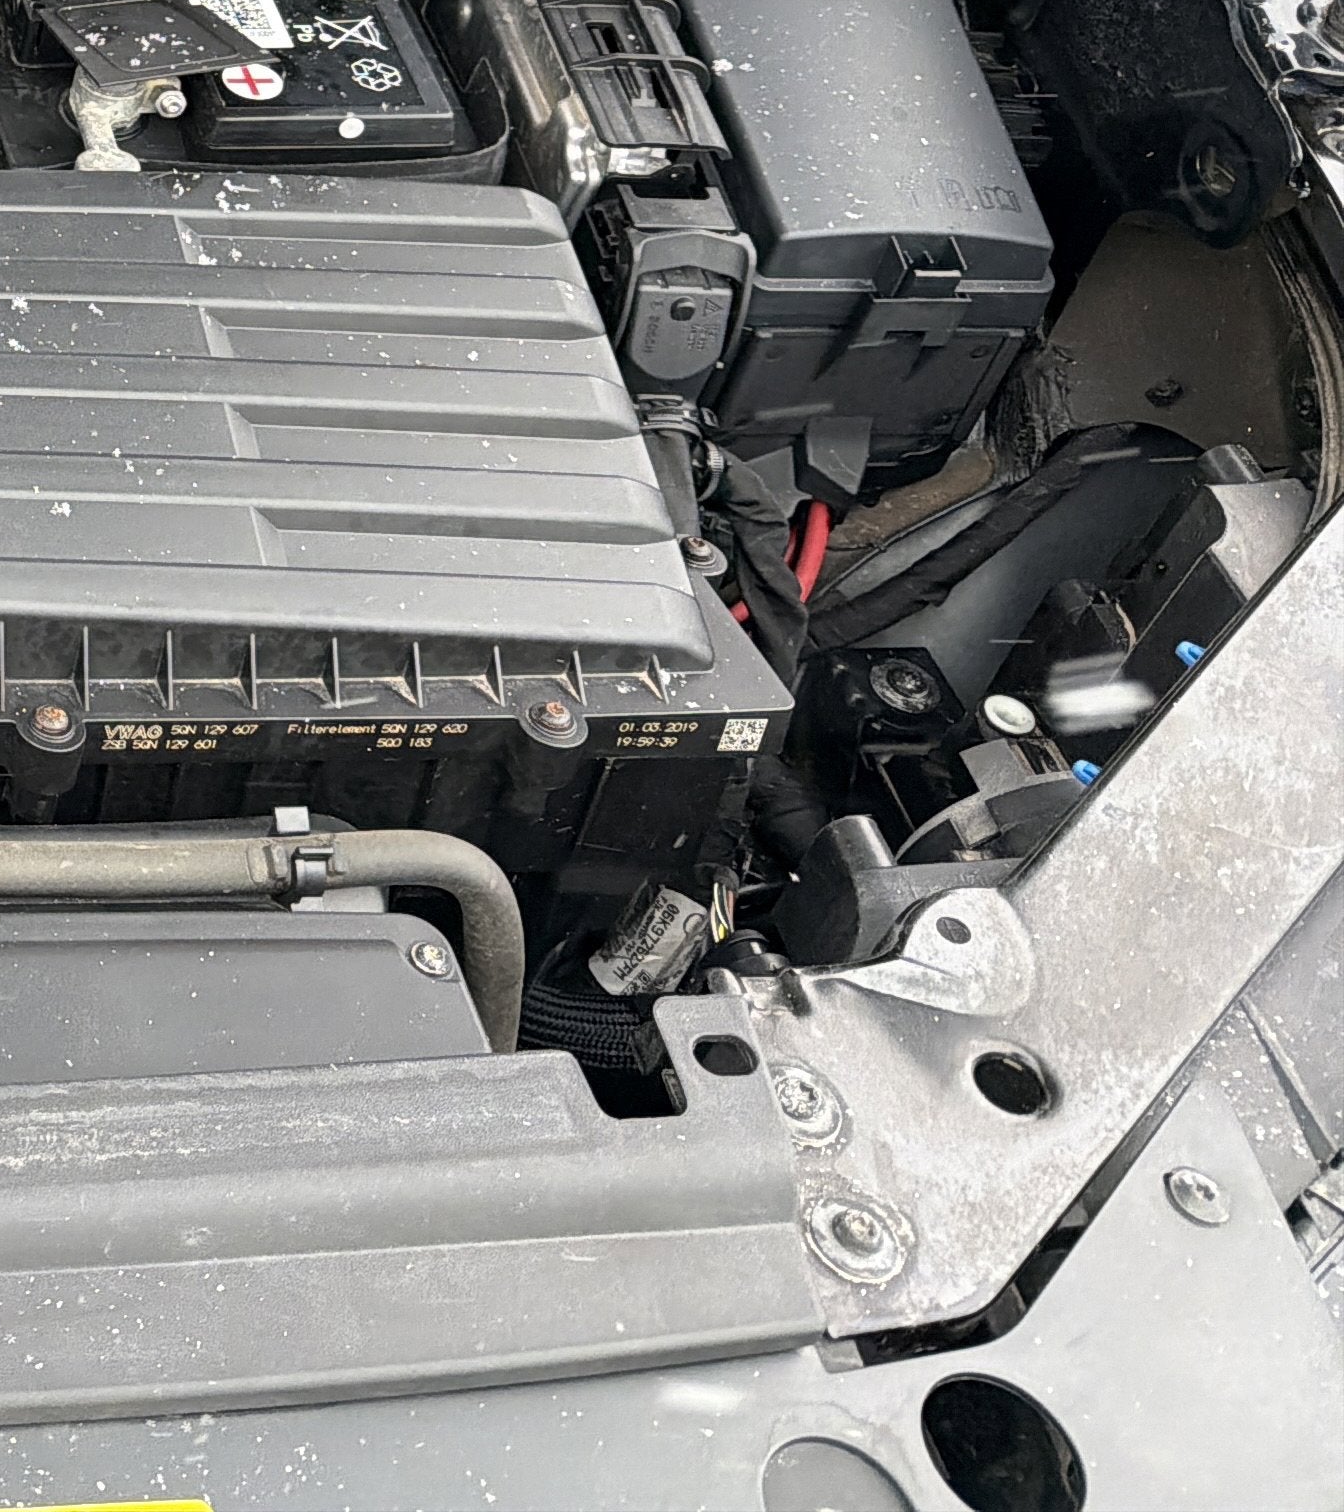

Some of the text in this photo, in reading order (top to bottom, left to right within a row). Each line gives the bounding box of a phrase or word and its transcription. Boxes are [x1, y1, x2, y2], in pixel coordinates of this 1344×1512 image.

[293, 23, 313, 42] Pb
[104, 724, 260, 739] VWAG 5QN 129 607
[286, 723, 468, 735] Filterelement 5QN 129 620
[618, 721, 698, 733] 01.03.2019
[101, 739, 218, 750] ZSB 5QN 129 601
[408, 737, 432, 748] 183
[615, 736, 678, 748] 19:59:39
